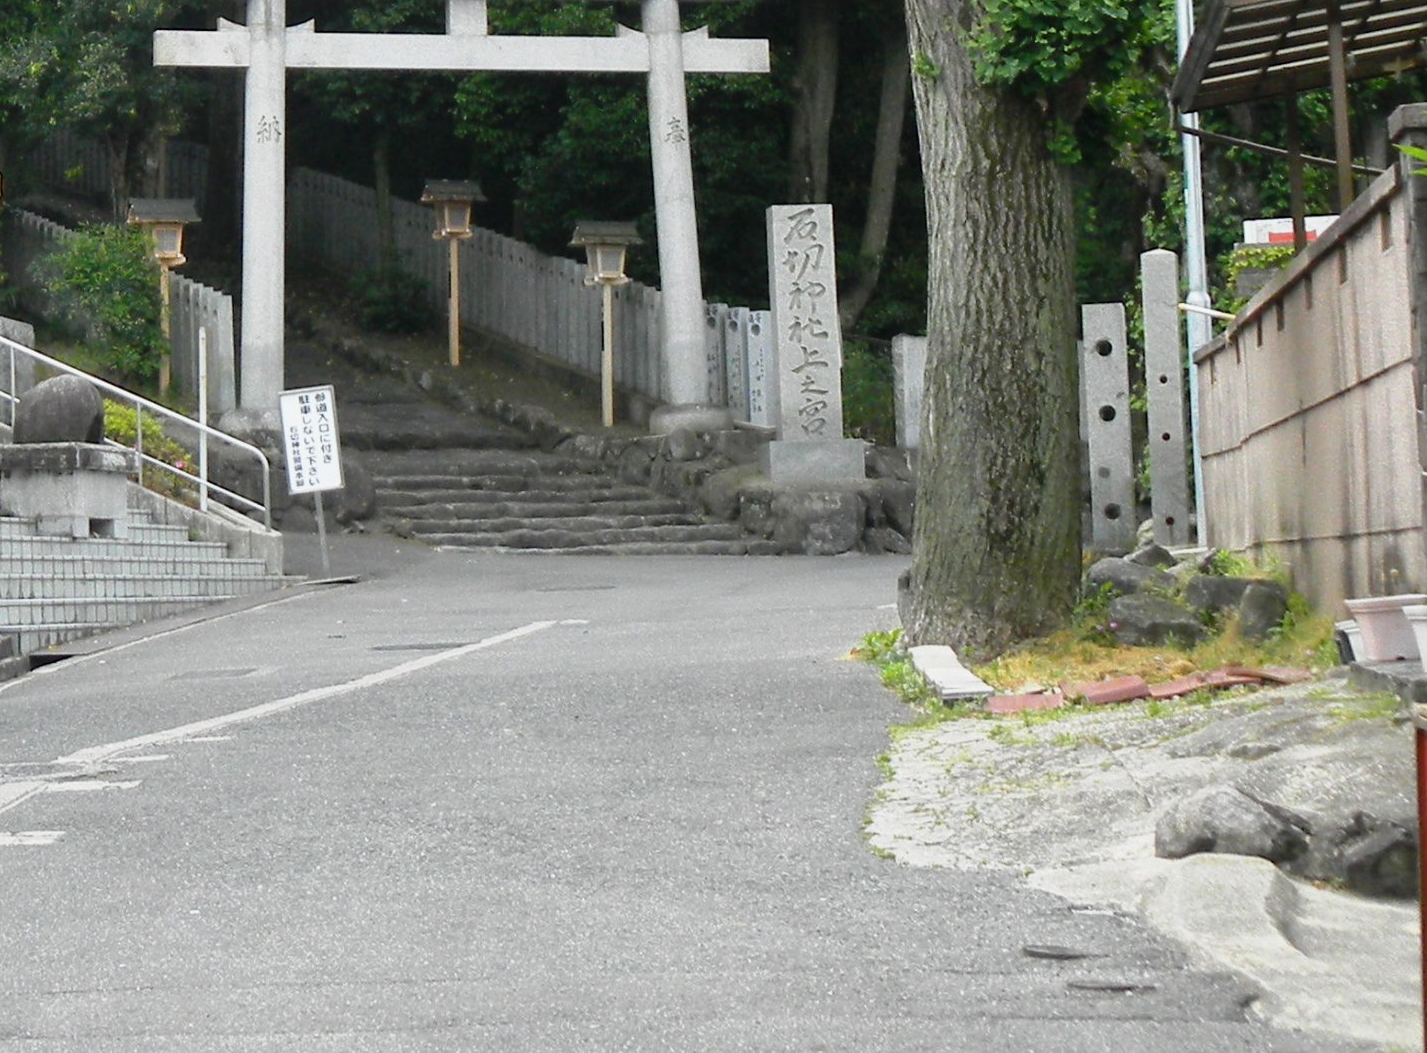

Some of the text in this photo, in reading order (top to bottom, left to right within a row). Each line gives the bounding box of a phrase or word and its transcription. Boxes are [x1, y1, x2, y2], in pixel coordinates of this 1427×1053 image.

[257, 115, 282, 144] 納
[782, 207, 830, 438] 石切神社上之宮
[298, 394, 321, 487] 駐車しないで下さい
